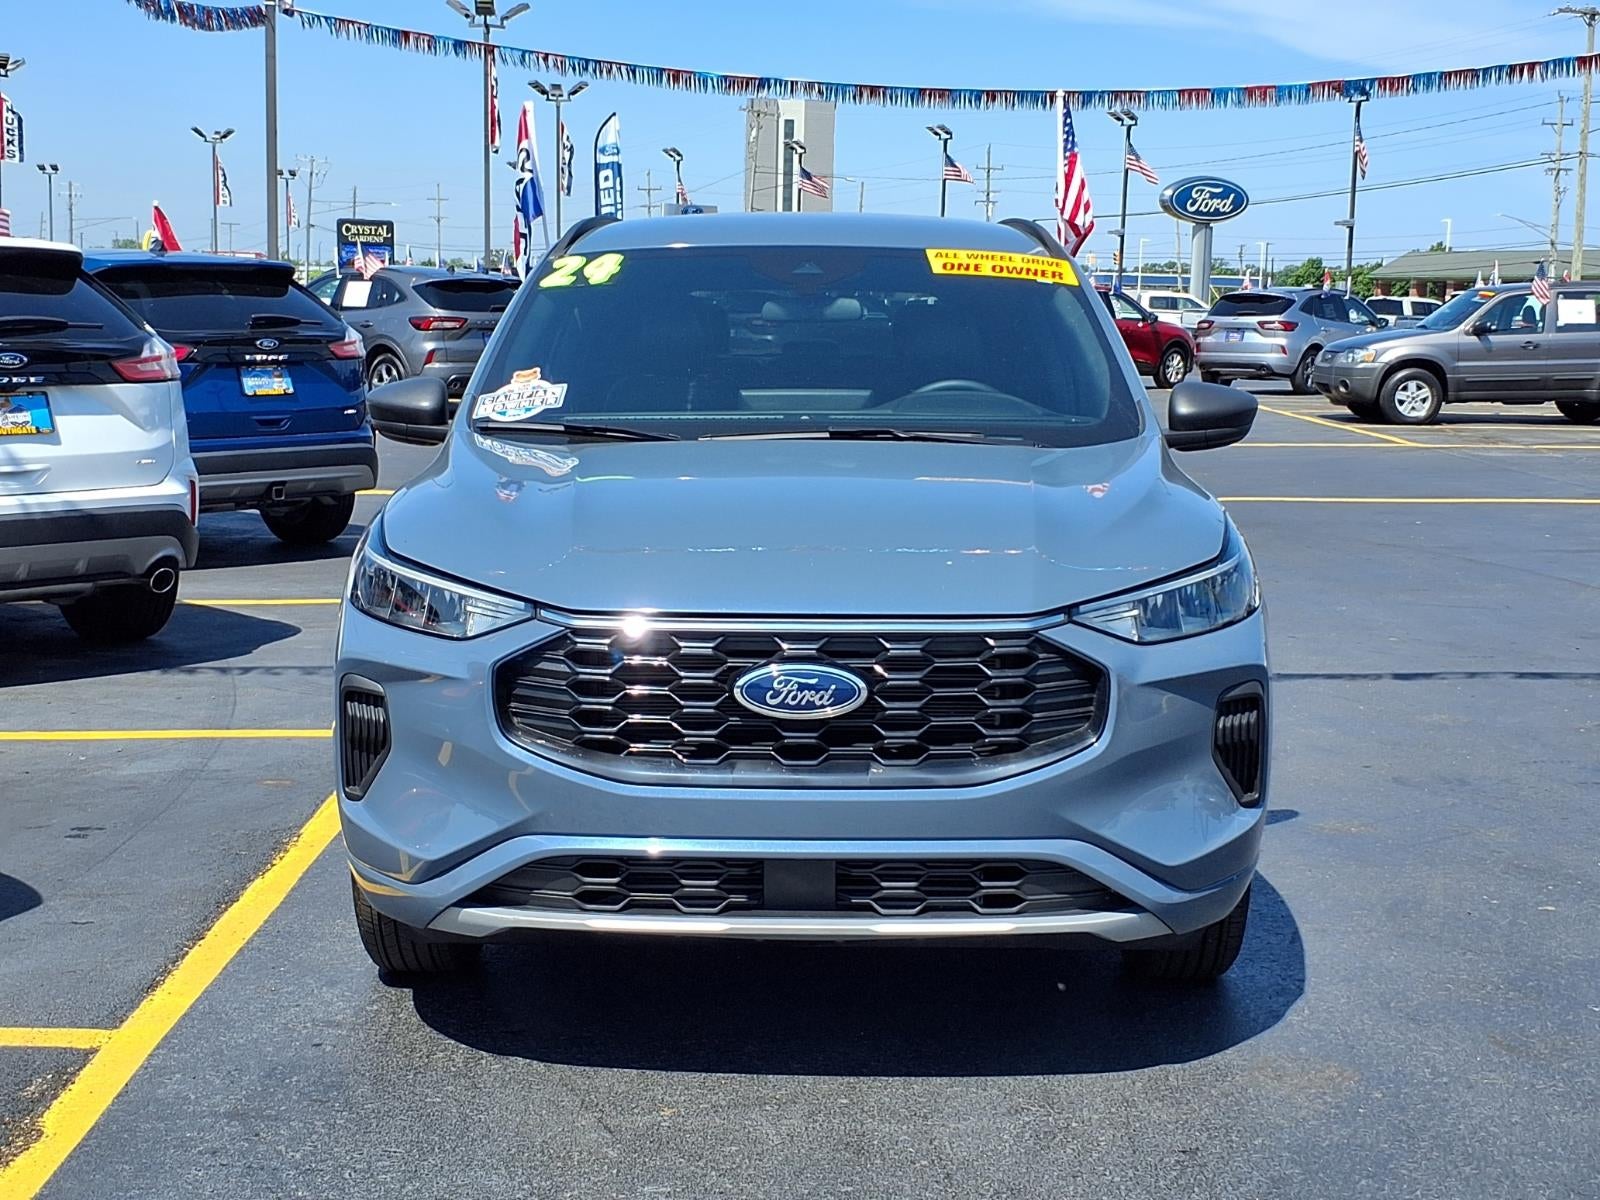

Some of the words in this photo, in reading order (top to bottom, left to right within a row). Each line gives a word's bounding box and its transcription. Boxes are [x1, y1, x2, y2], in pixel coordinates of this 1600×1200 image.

[1186, 185, 1236, 212] Ford
[342, 223, 391, 237] CRYSTAL
[348, 234, 384, 243] GARDENS
[934, 251, 961, 259] ALL
[966, 252, 1017, 263] WHEEL
[1021, 257, 1063, 268] DRIVE
[539, 253, 624, 288] 24
[942, 262, 983, 273] ONE
[991, 264, 1064, 280] OWNER
[765, 675, 836, 706] Ford
